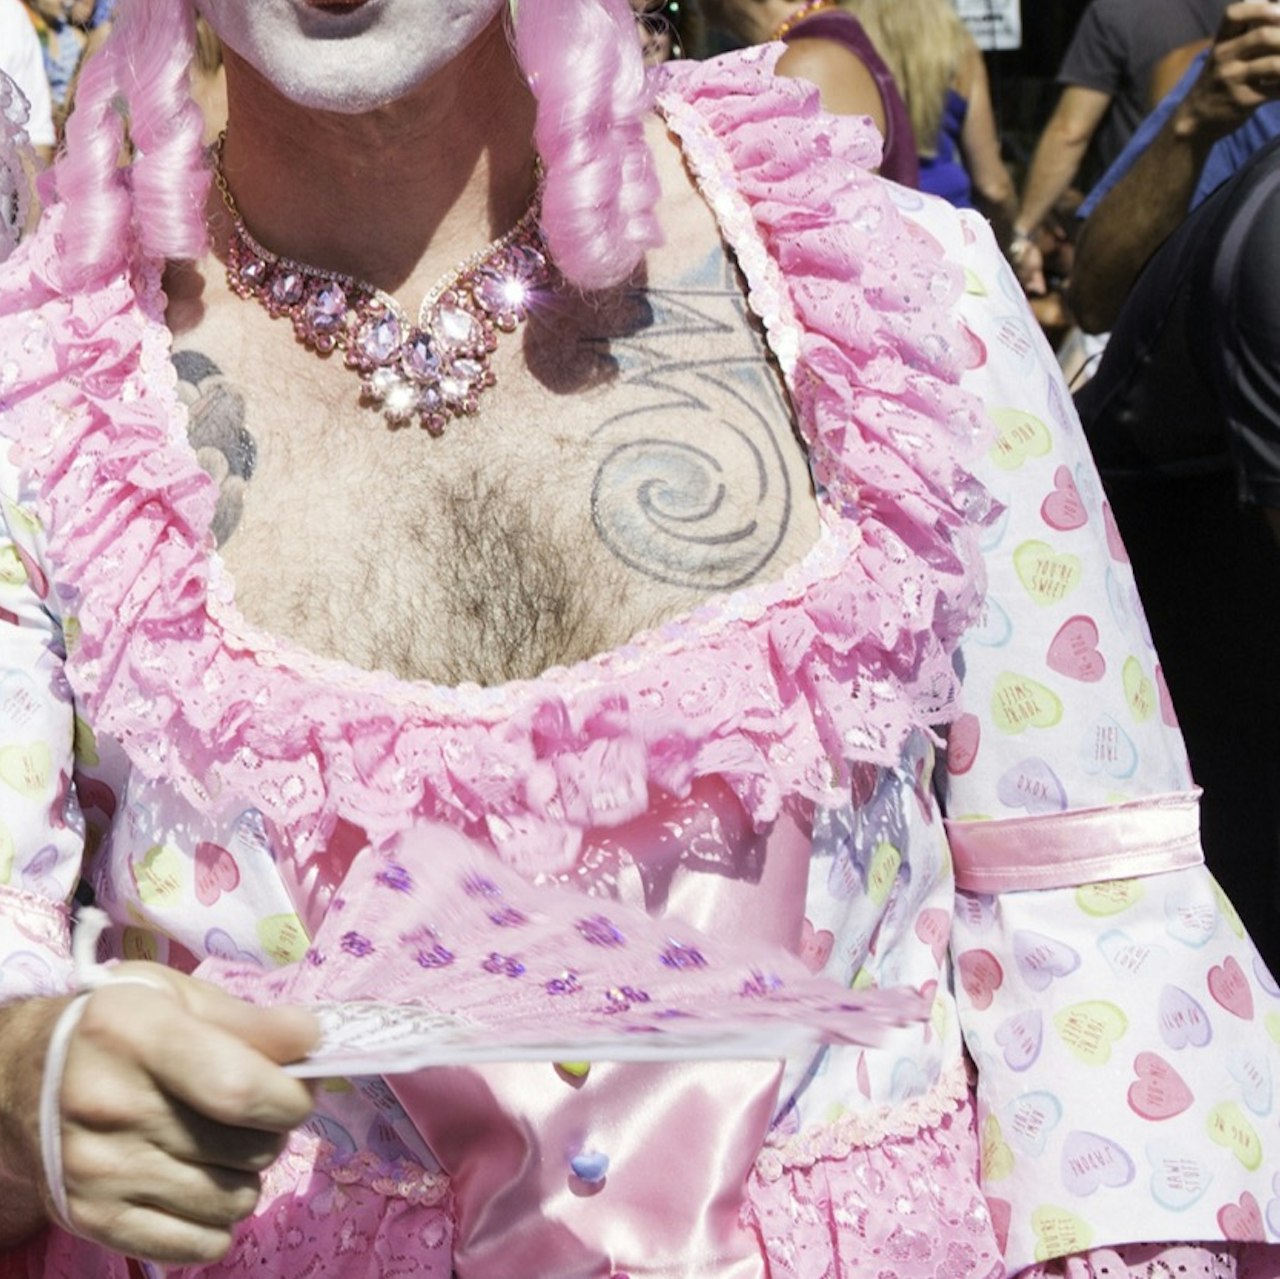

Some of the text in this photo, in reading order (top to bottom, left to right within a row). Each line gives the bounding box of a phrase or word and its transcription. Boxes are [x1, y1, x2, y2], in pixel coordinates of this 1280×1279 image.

[1036, 558, 1073, 582] YOU'RE
[1031, 576, 1067, 599] SWEET
[1016, 774, 1050, 801] XOXO
